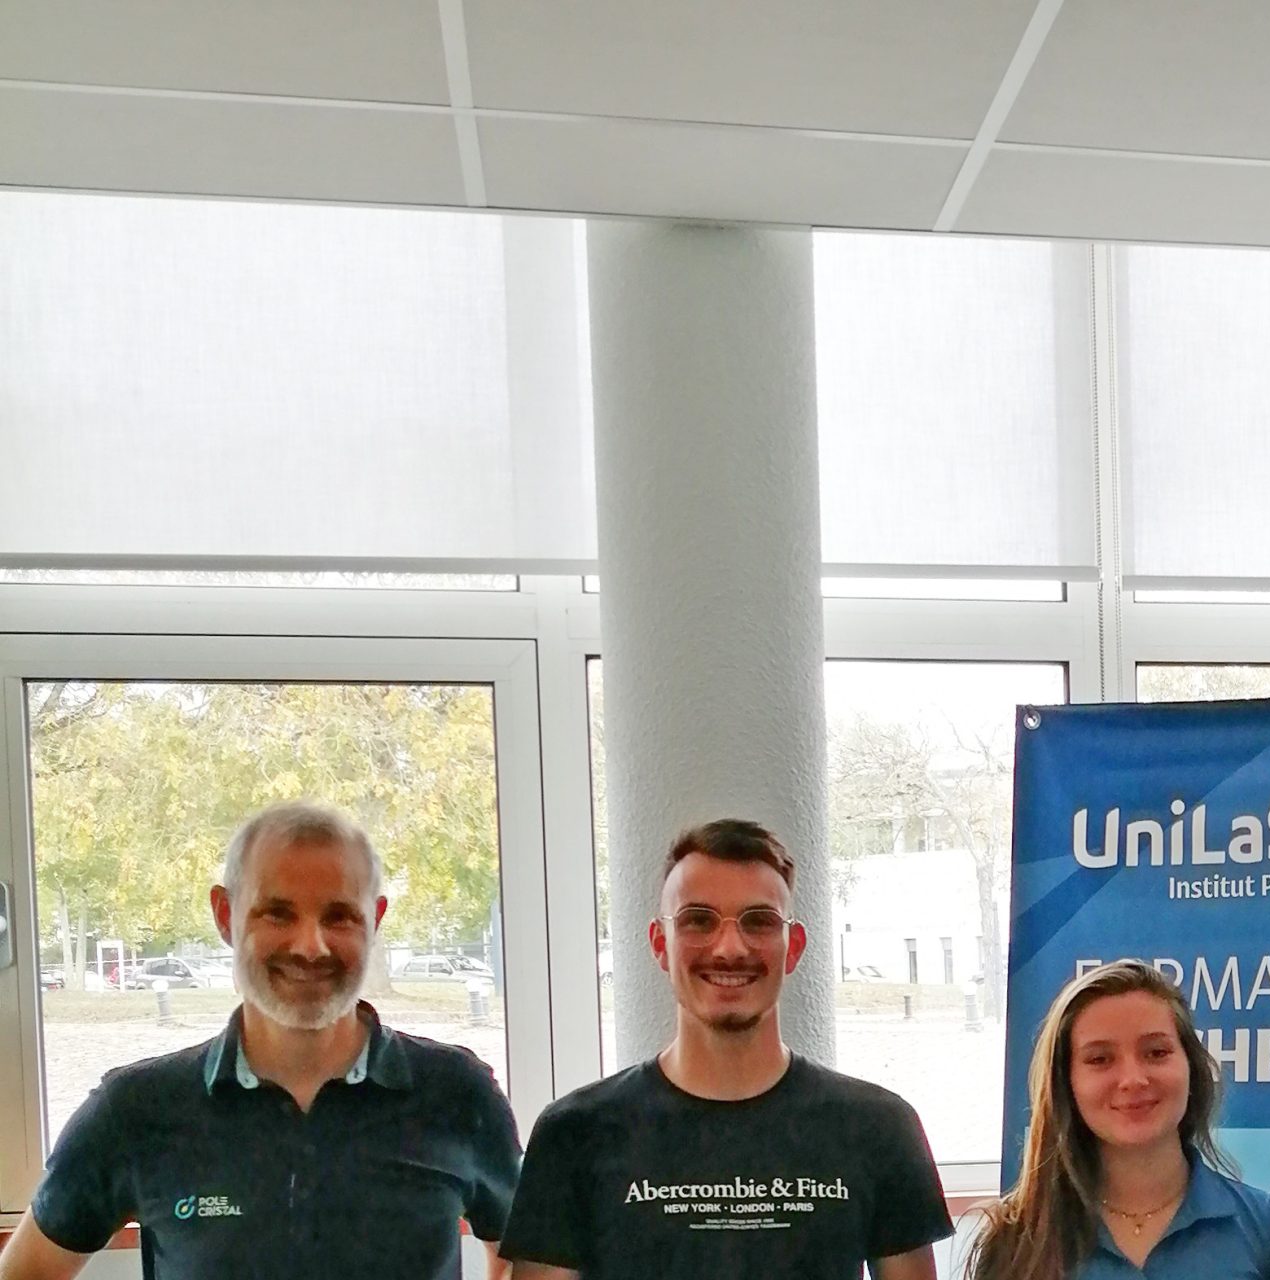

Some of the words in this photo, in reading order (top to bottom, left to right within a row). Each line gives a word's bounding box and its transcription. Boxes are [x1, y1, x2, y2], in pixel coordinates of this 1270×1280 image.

[1169, 874, 1256, 899] Institut
[624, 1176, 768, 1204] Abercrombie
[770, 1178, 794, 1198] &
[796, 1178, 850, 1200] Fitch
[664, 1203, 689, 1214] NEW
[691, 1203, 722, 1214] YORK
[730, 1202, 775, 1214] LONDON
[783, 1202, 815, 1213] PARIS
